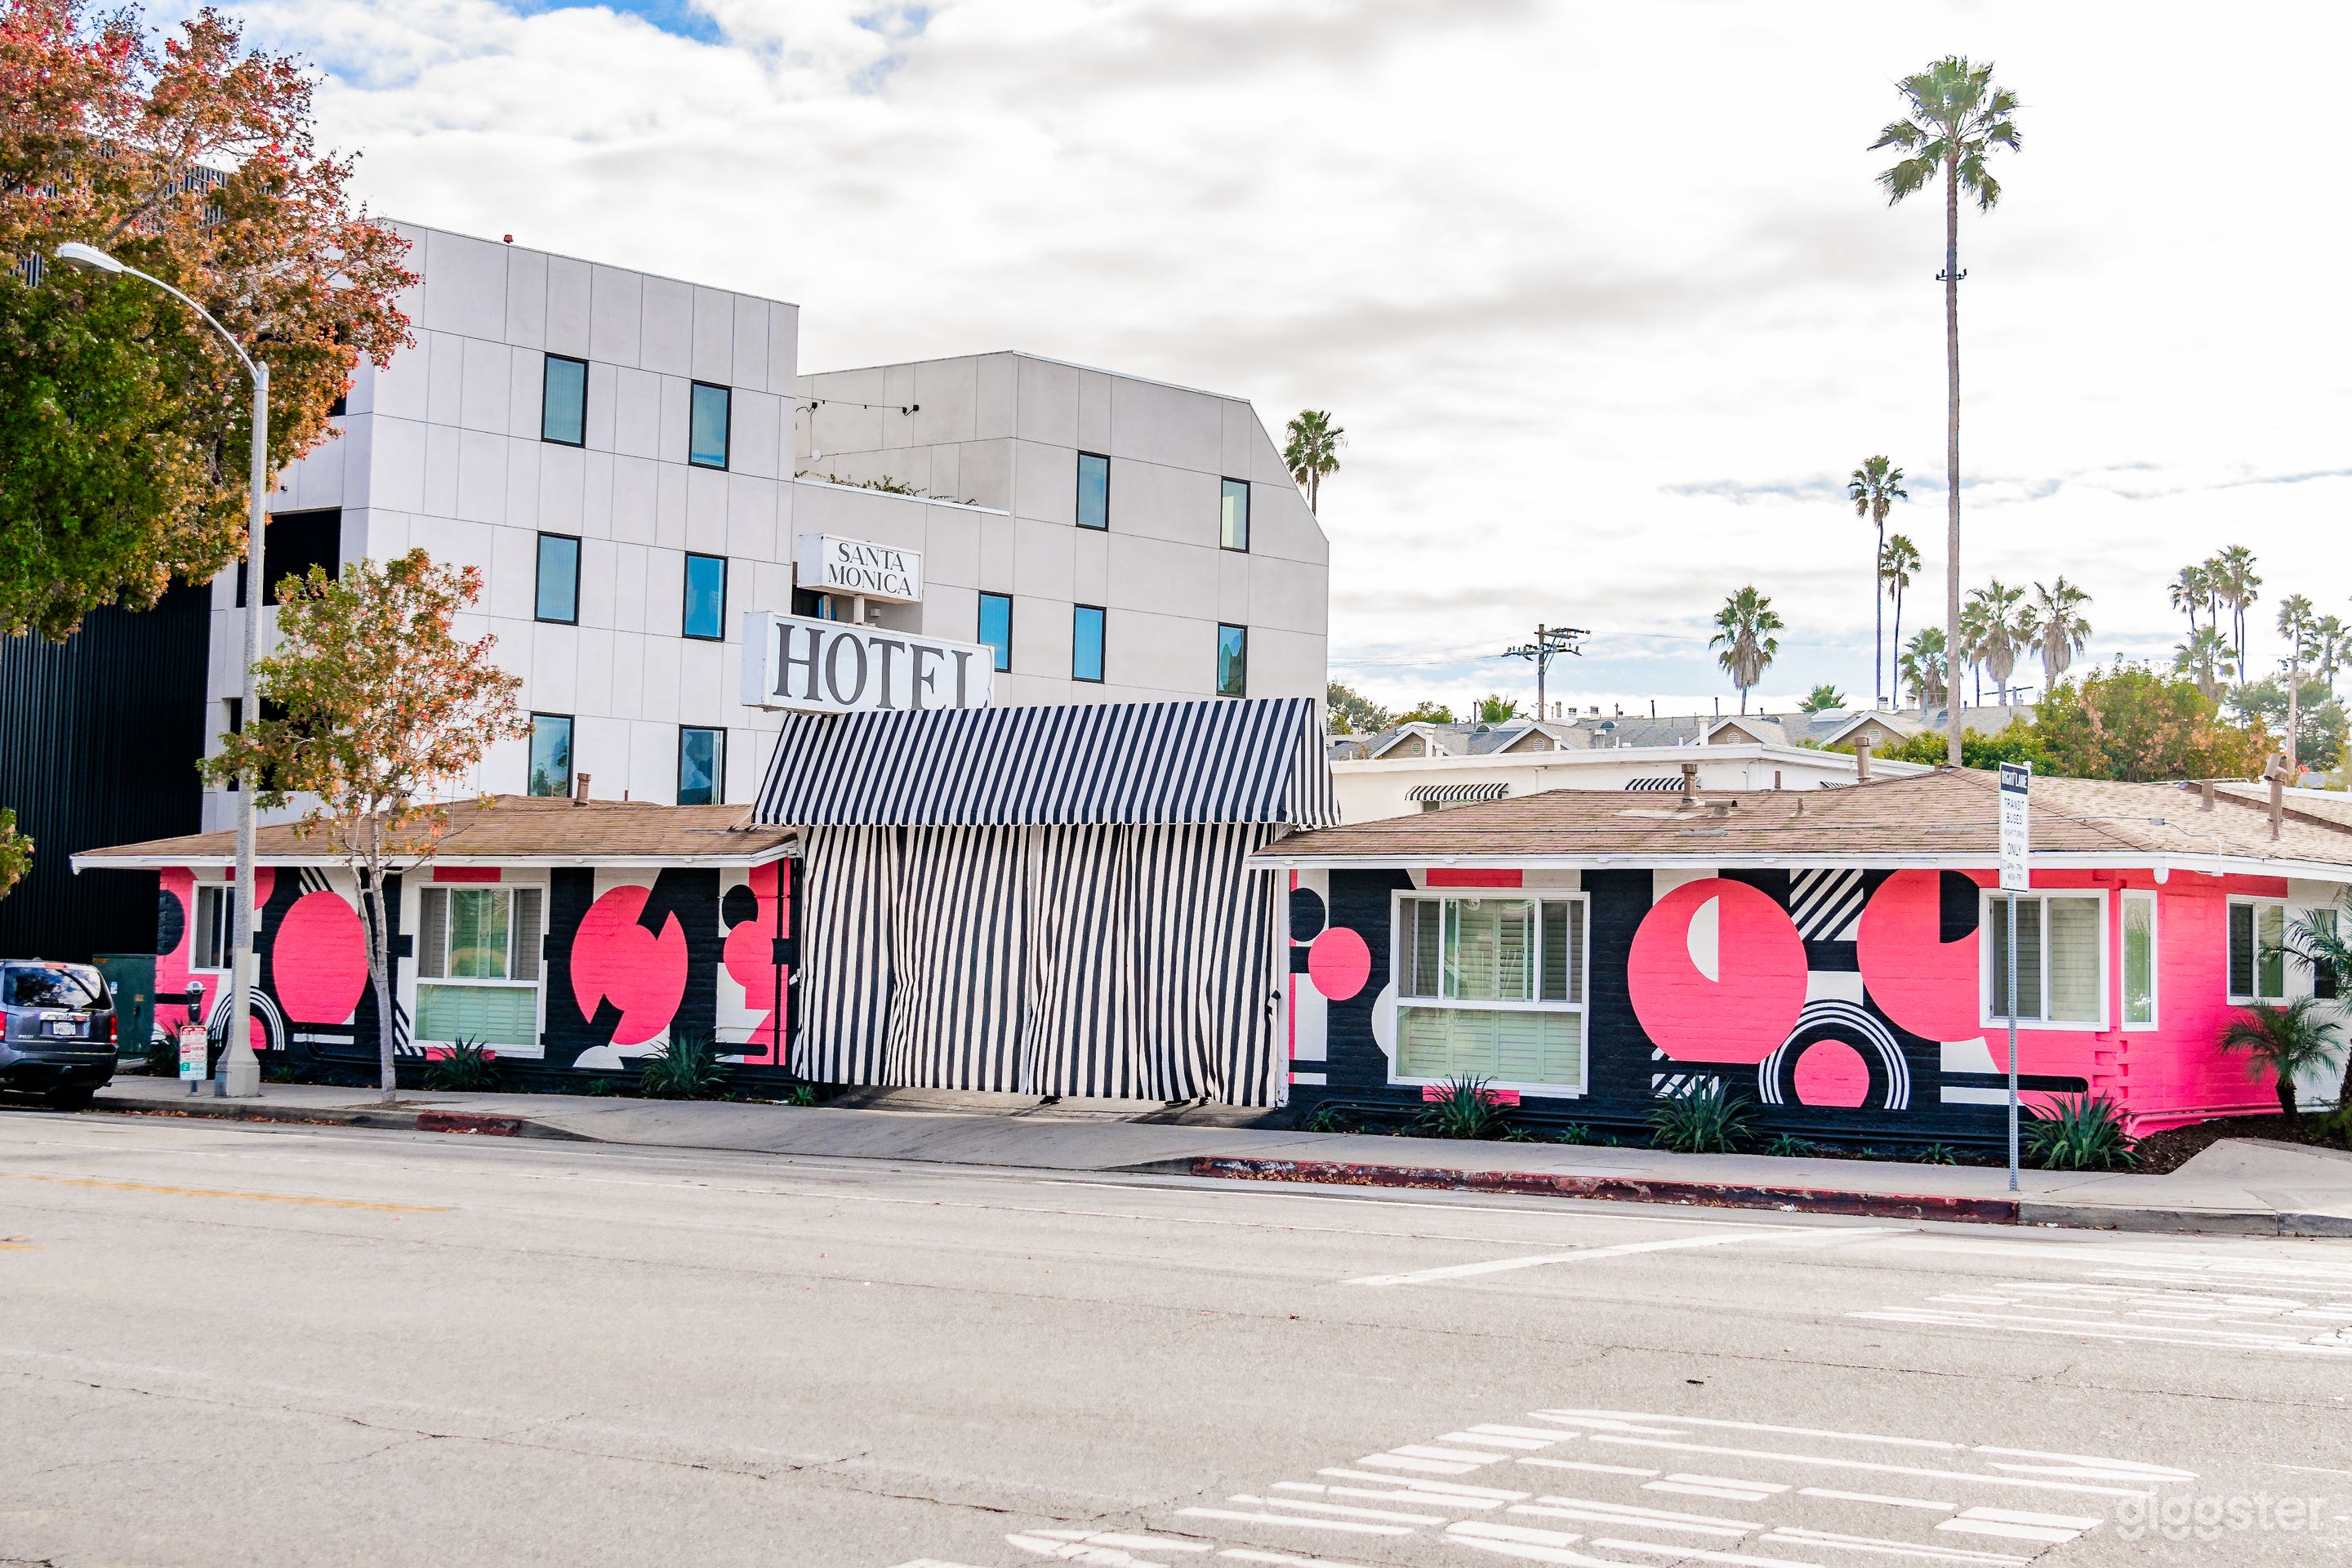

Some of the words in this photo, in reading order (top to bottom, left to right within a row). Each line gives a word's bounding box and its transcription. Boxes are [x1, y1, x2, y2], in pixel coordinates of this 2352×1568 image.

[838, 542, 905, 572] SANTA
[828, 564, 912, 596] MONICA
[773, 621, 988, 710] HOTEL
[2002, 770, 2015, 786] RIGHT
[2016, 773, 2027, 789] LANE
[2004, 798, 2024, 810] TRANSIT
[2007, 813, 2022, 824] BUSES
[2007, 843, 2022, 857] ONLY
